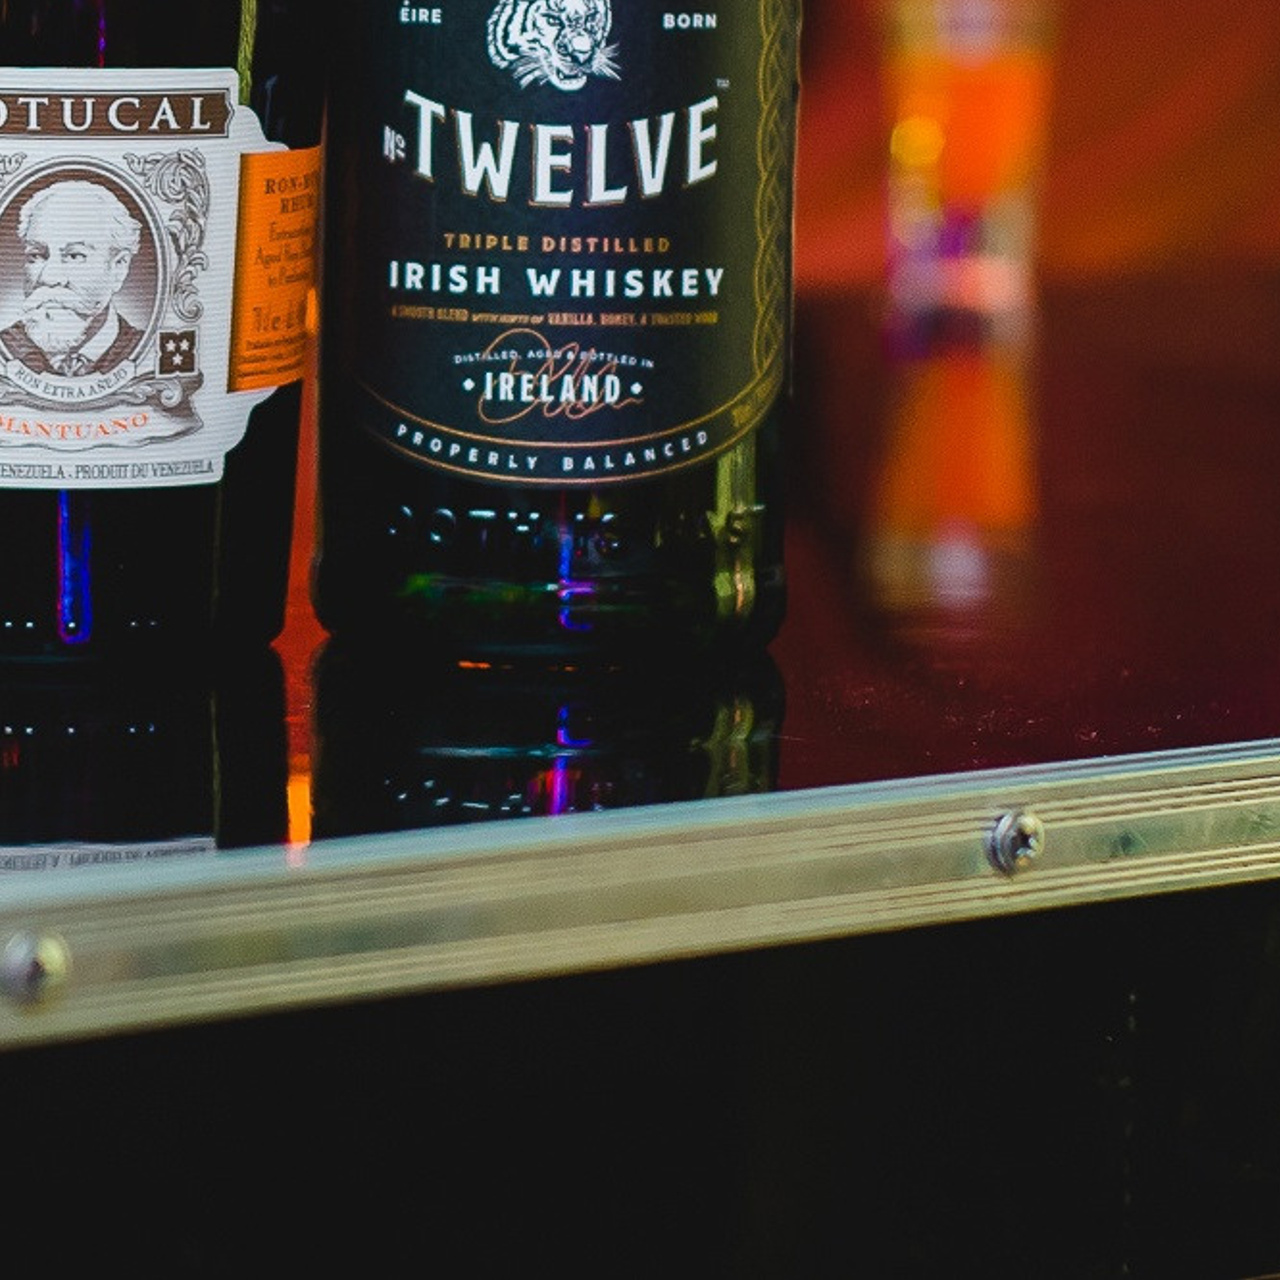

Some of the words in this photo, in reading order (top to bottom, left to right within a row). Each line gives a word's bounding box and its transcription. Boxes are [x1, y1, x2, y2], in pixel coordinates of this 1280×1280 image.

[663, 13, 717, 30] BORN
[404, 89, 719, 208] TWELVE
[443, 232, 530, 252] TRIPLE
[541, 235, 670, 253] DISTILLED
[389, 260, 501, 295] IRISH
[526, 267, 724, 298] WHISKEY
[641, 358, 654, 368] IN
[15, 369, 39, 389] RON
[42, 384, 86, 399] EXTRA
[89, 368, 128, 397] AÑEJO
[484, 371, 621, 404] IRELAND
[397, 423, 538, 470] PROPERLY
[562, 430, 708, 472] BALANCED
[75, 463, 132, 479] PRODUIT
[132, 462, 149, 478] DU
[150, 459, 215, 477] VENEZUELA
